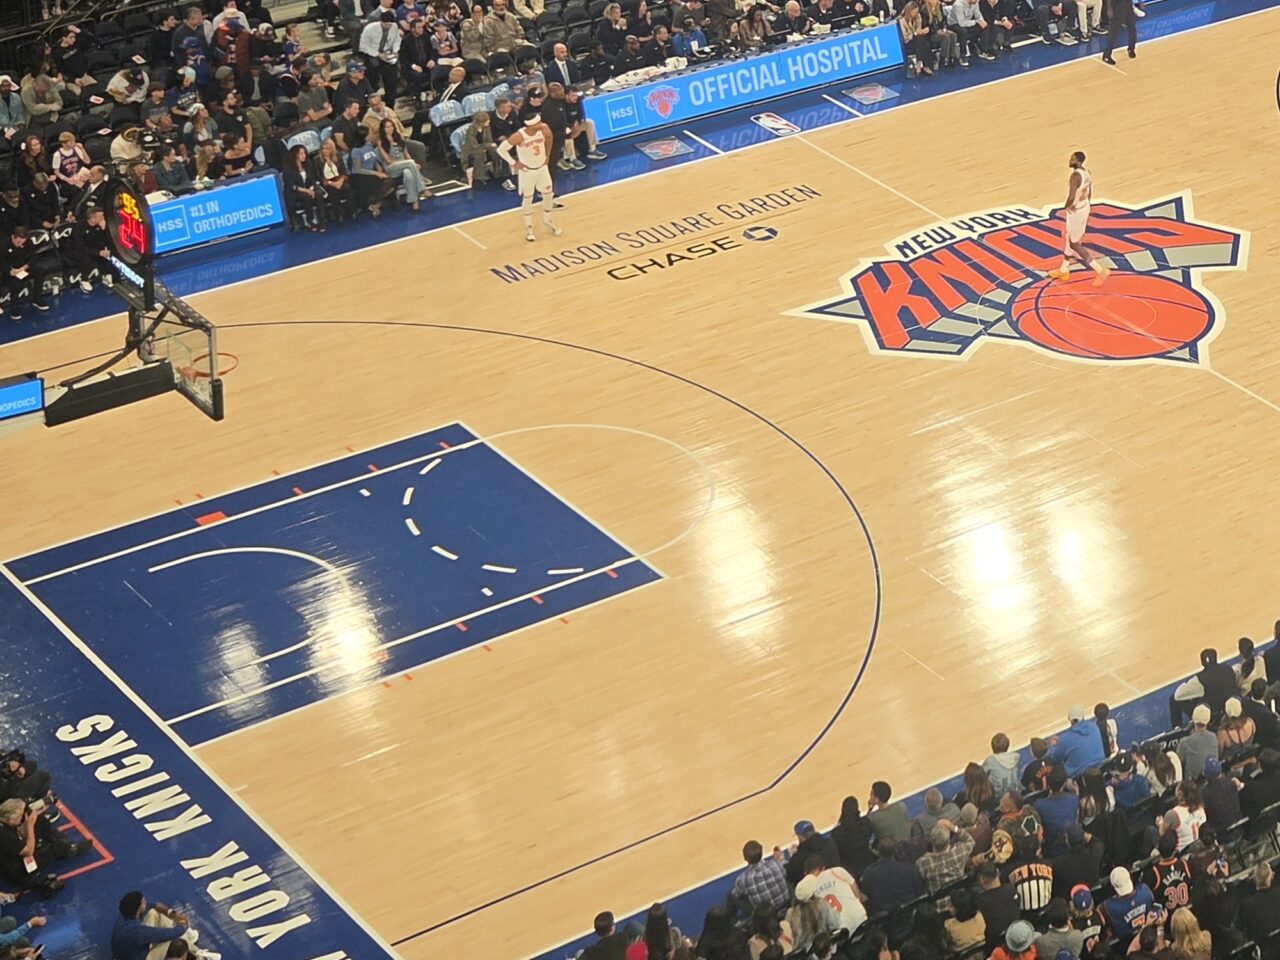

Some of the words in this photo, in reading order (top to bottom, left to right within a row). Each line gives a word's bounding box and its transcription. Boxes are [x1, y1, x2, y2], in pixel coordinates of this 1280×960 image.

[612, 106, 633, 119] HSS
[688, 62, 786, 107] OFFICIAL
[787, 36, 888, 82] HOSPITAL
[117, 209, 146, 254] 24
[158, 218, 184, 233] HSS
[190, 205, 205, 218] #1
[206, 200, 219, 214] IN
[193, 203, 273, 234] ORTHOPEDICS
[489, 240, 621, 284] MADISON
[616, 211, 724, 249] SQUARE
[716, 184, 823, 221] GARDEN
[896, 225, 955, 258] NEW
[956, 208, 1042, 237] YORK
[607, 236, 743, 281] CHASE
[55, 714, 213, 842] KNICKS
[179, 840, 312, 949] YORK
[1164, 882, 1189, 909] 30
